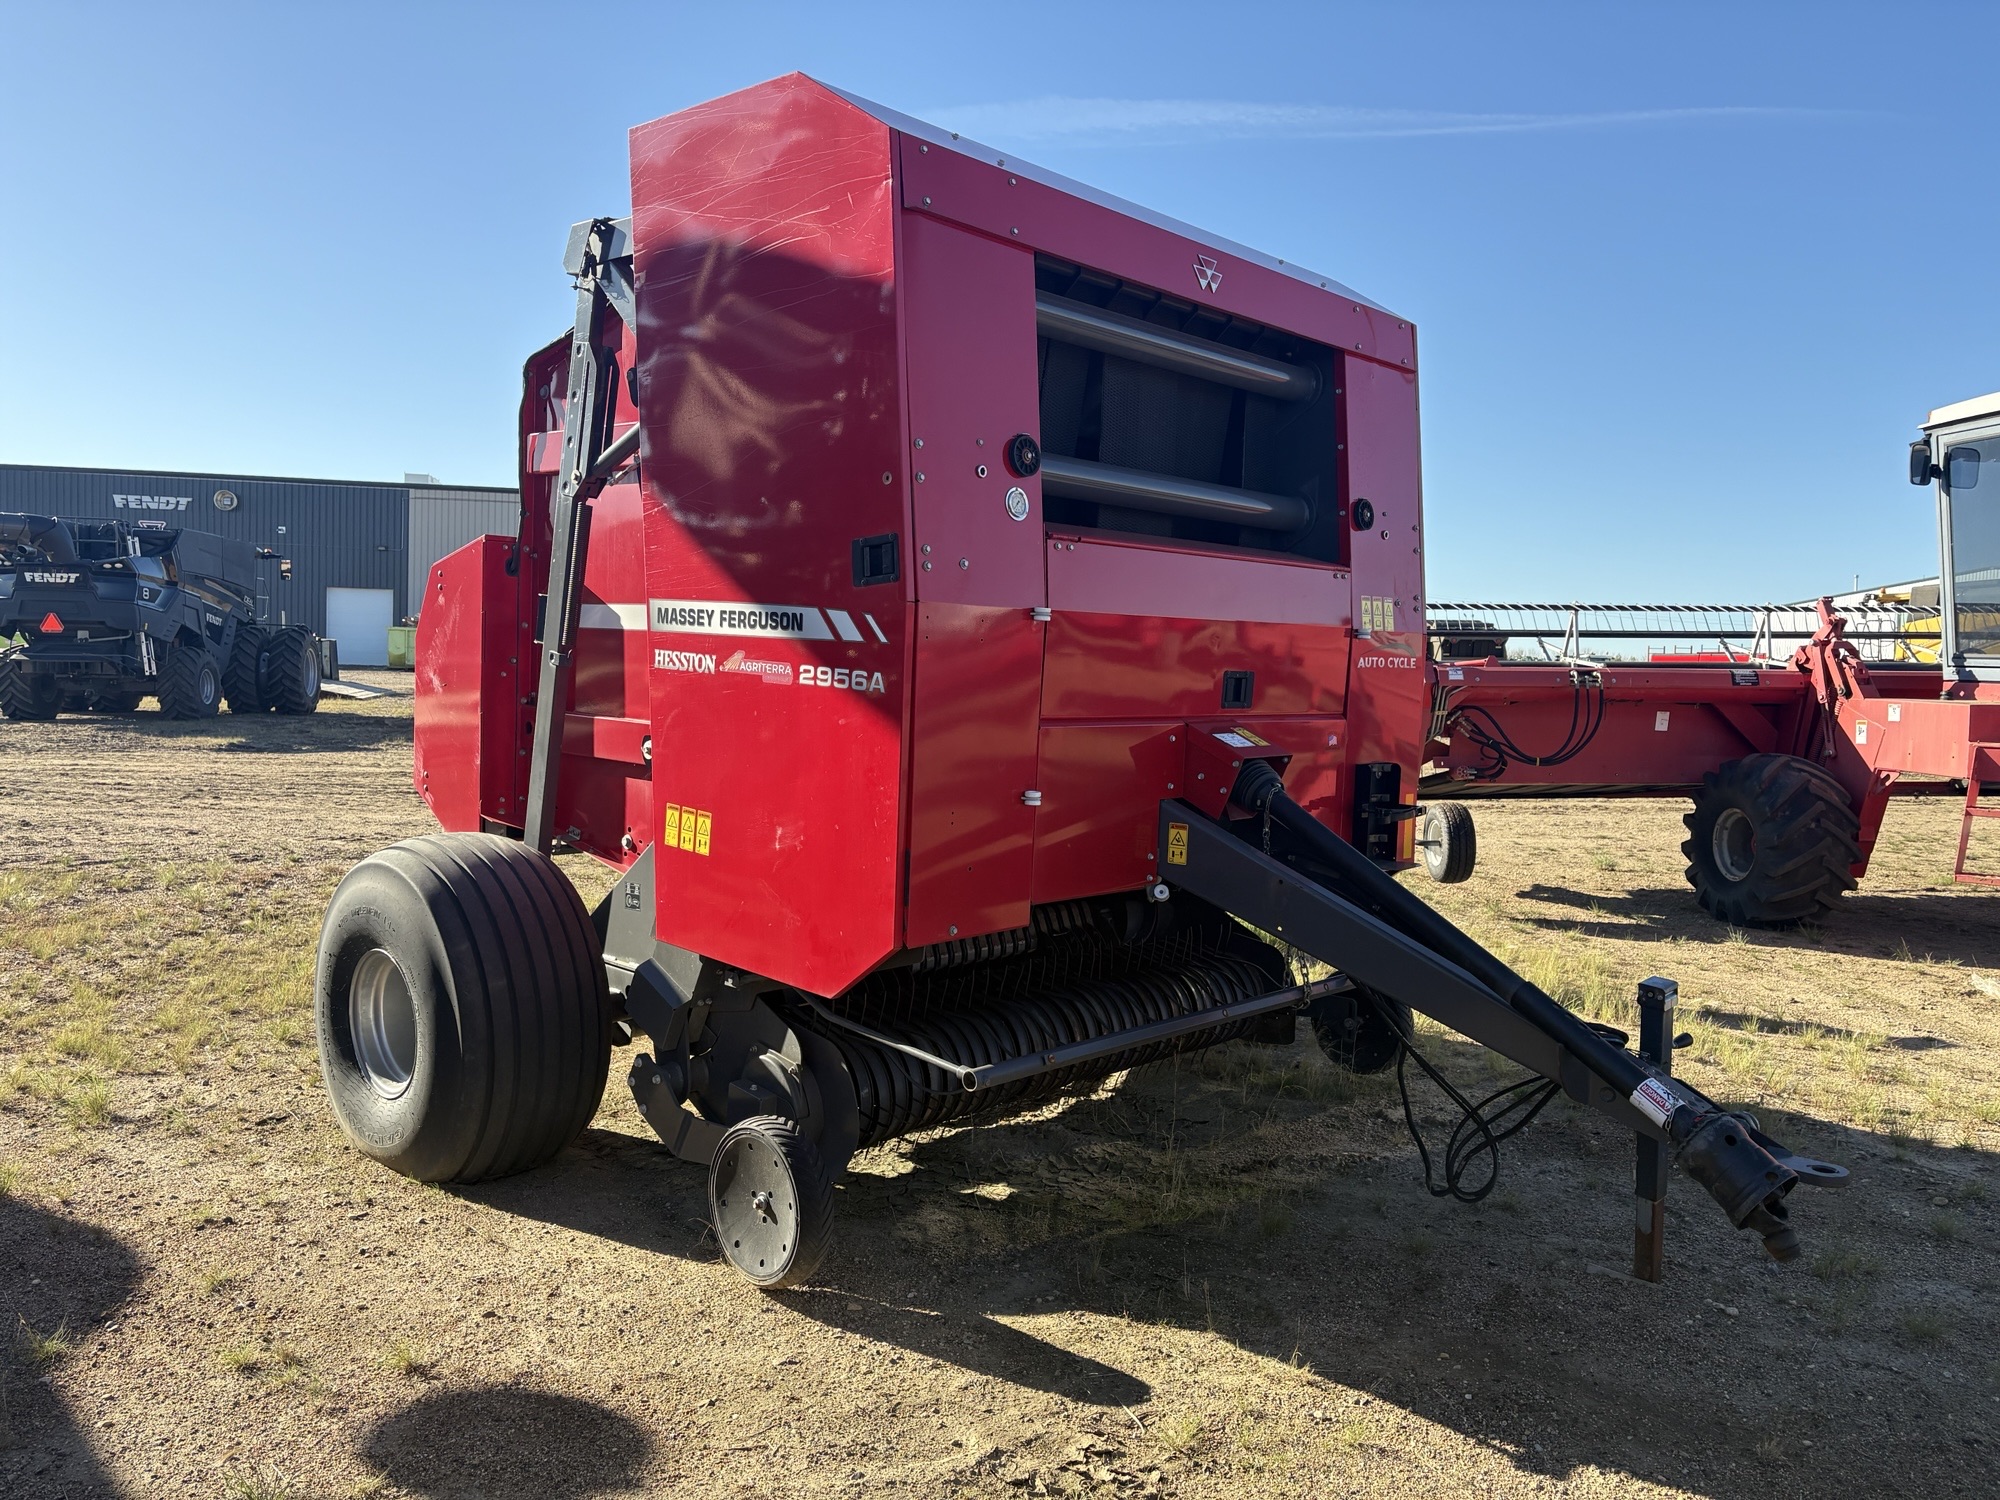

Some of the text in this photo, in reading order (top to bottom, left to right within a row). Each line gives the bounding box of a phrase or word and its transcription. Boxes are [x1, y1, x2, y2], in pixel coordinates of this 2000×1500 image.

[112, 494, 193, 511] FENDT
[24, 572, 80, 584] FENDT
[142, 587, 150, 600] 8
[206, 612, 223, 627] FENDT
[657, 607, 804, 632] MASSEY FERGUSON
[654, 649, 716, 675] HESSTON
[739, 661, 792, 676] AGRITERRA
[1357, 656, 1417, 669] AUTO CYCLE
[799, 664, 886, 694] 2956A
[1641, 1083, 1666, 1106] DANGER
